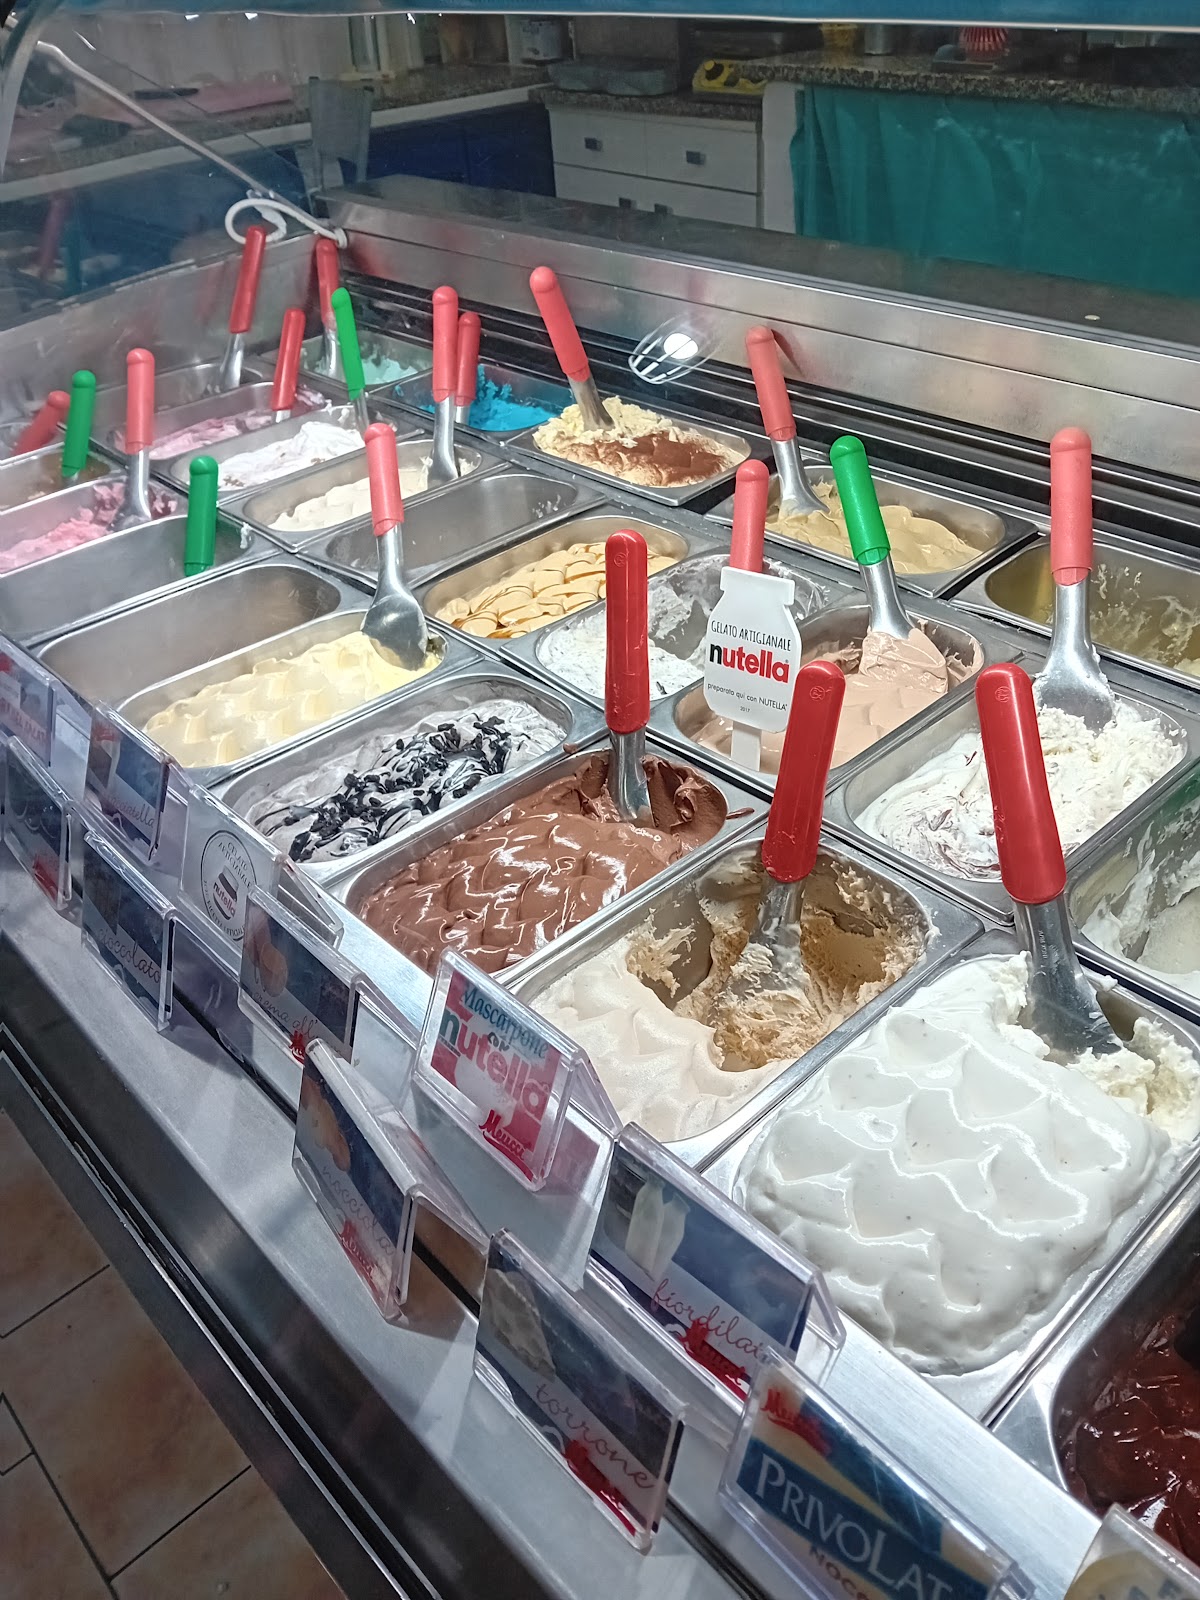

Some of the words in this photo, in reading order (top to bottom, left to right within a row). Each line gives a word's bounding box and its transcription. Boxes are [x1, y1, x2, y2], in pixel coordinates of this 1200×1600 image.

[709, 643, 790, 684] nutella
[711, 620, 738, 639] GELATO
[738, 628, 791, 651] ARTIGIANALE
[707, 683, 735, 696] preparato
[735, 691, 746, 699] qui
[213, 881, 236, 918] nutella
[462, 985, 550, 1059] Mascarpone
[438, 1007, 551, 1115] nutella
[535, 1383, 655, 1489] torrone
[755, 1453, 953, 1600] PRIVOLAT
